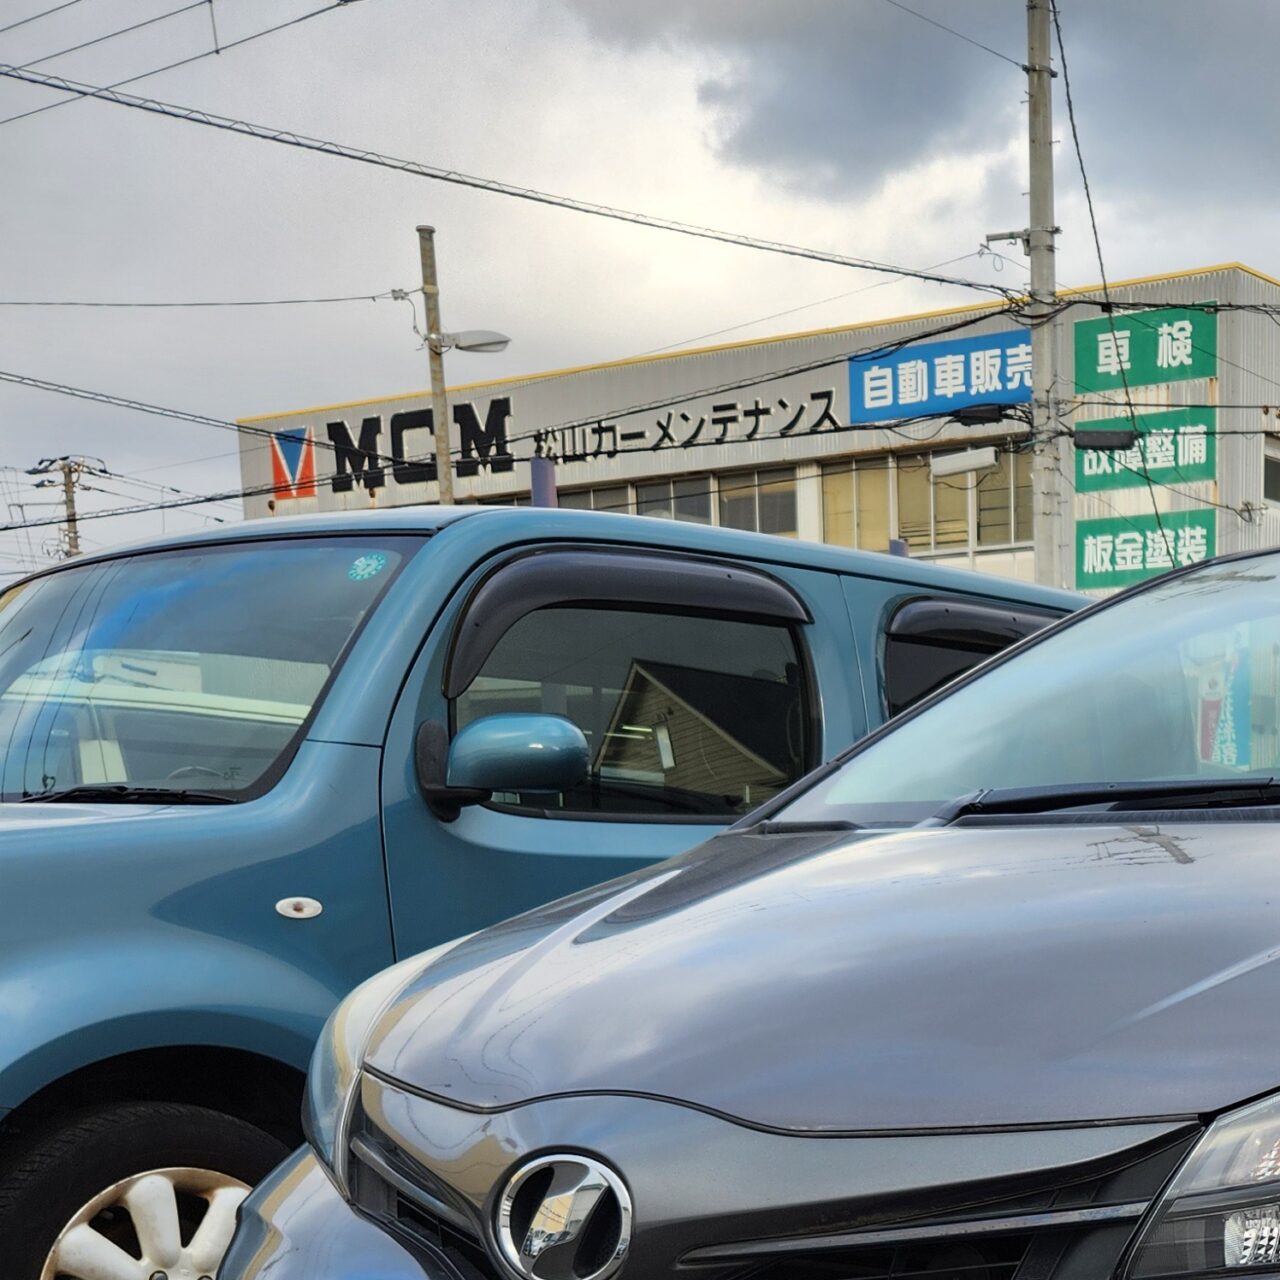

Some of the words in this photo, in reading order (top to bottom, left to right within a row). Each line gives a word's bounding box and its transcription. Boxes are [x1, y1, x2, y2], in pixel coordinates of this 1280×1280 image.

[863, 344, 1032, 409] 自動車販売
[1097, 320, 1193, 375] 車検
[326, 396, 515, 492] MCM
[1084, 526, 1207, 573] 板金塗装
